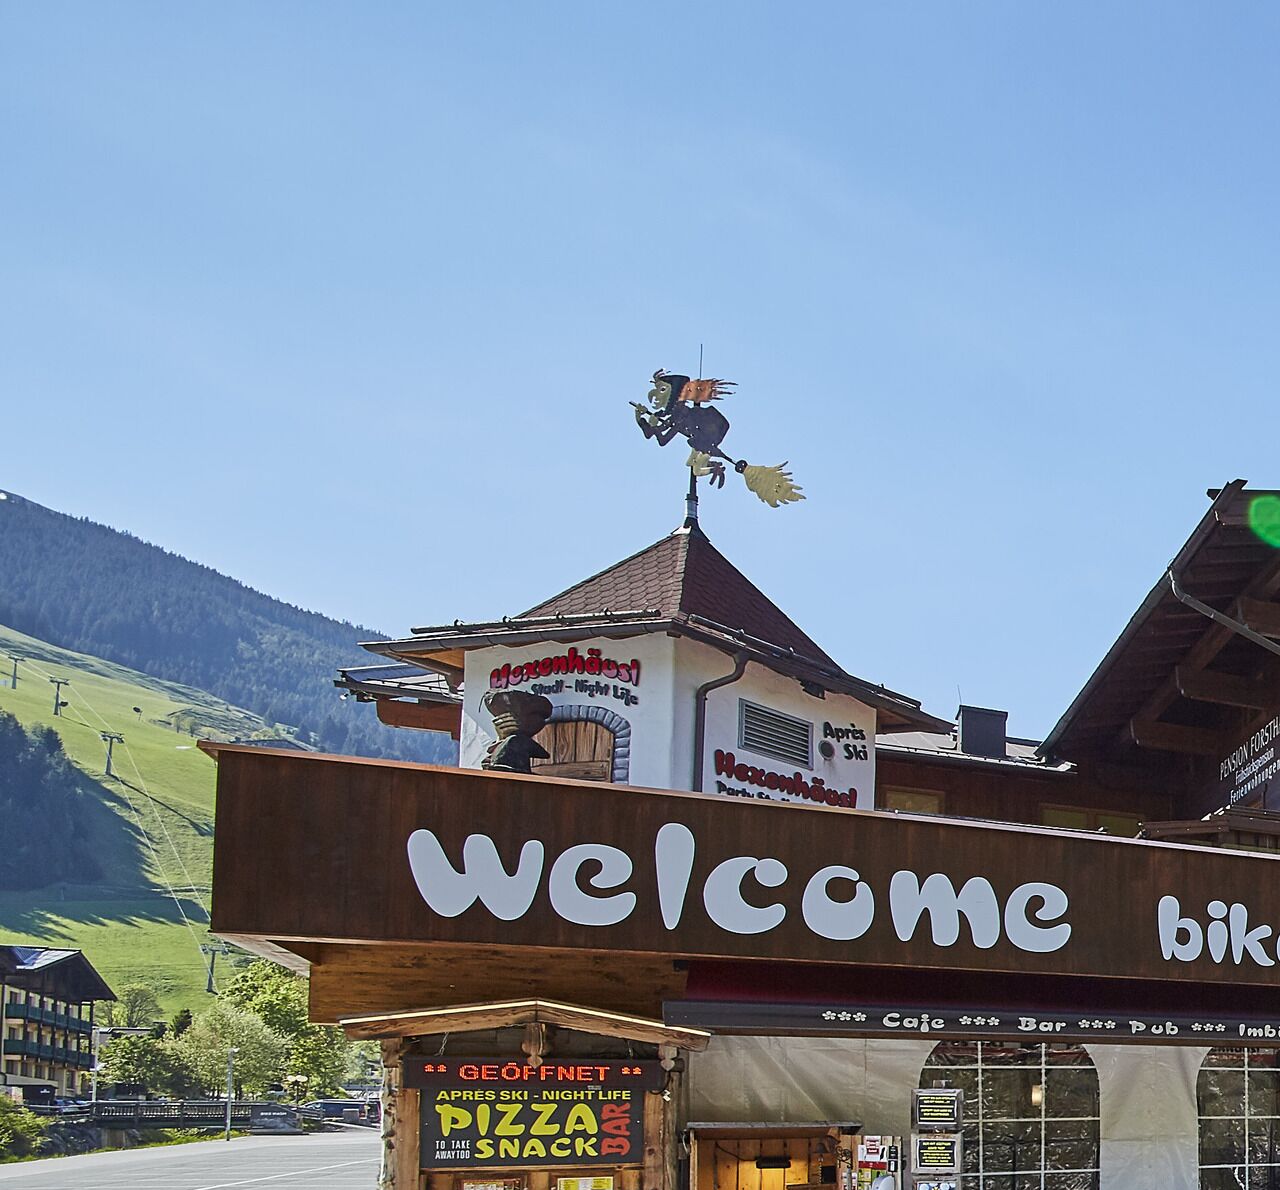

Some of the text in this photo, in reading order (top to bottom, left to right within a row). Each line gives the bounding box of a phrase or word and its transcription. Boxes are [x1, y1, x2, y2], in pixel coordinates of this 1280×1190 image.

[489, 646, 641, 690] Hexenhäusl
[574, 678, 610, 698] Night
[612, 684, 640, 707] Life
[823, 721, 867, 743] Après
[843, 743, 869, 761] Ski
[1219, 741, 1249, 781] PENSION
[714, 748, 858, 809] Hexenhäusl
[1229, 758, 1280, 805] Ferienwohnungen
[406, 822, 1072, 954] welcome
[882, 1012, 945, 1034] Cafe
[1017, 1016, 1067, 1033] Bar
[1129, 1020, 1180, 1036] Pub
[458, 1062, 610, 1082] GEÖFFNET
[499, 1090, 529, 1101] SKI
[542, 1090, 599, 1101] NIGHT
[599, 1090, 632, 1101] LIFE
[434, 1103, 599, 1137] PIZZA
[601, 1102, 631, 1157] BAR
[435, 1140, 471, 1150] TO TAKE
[474, 1137, 599, 1159] SNACK
